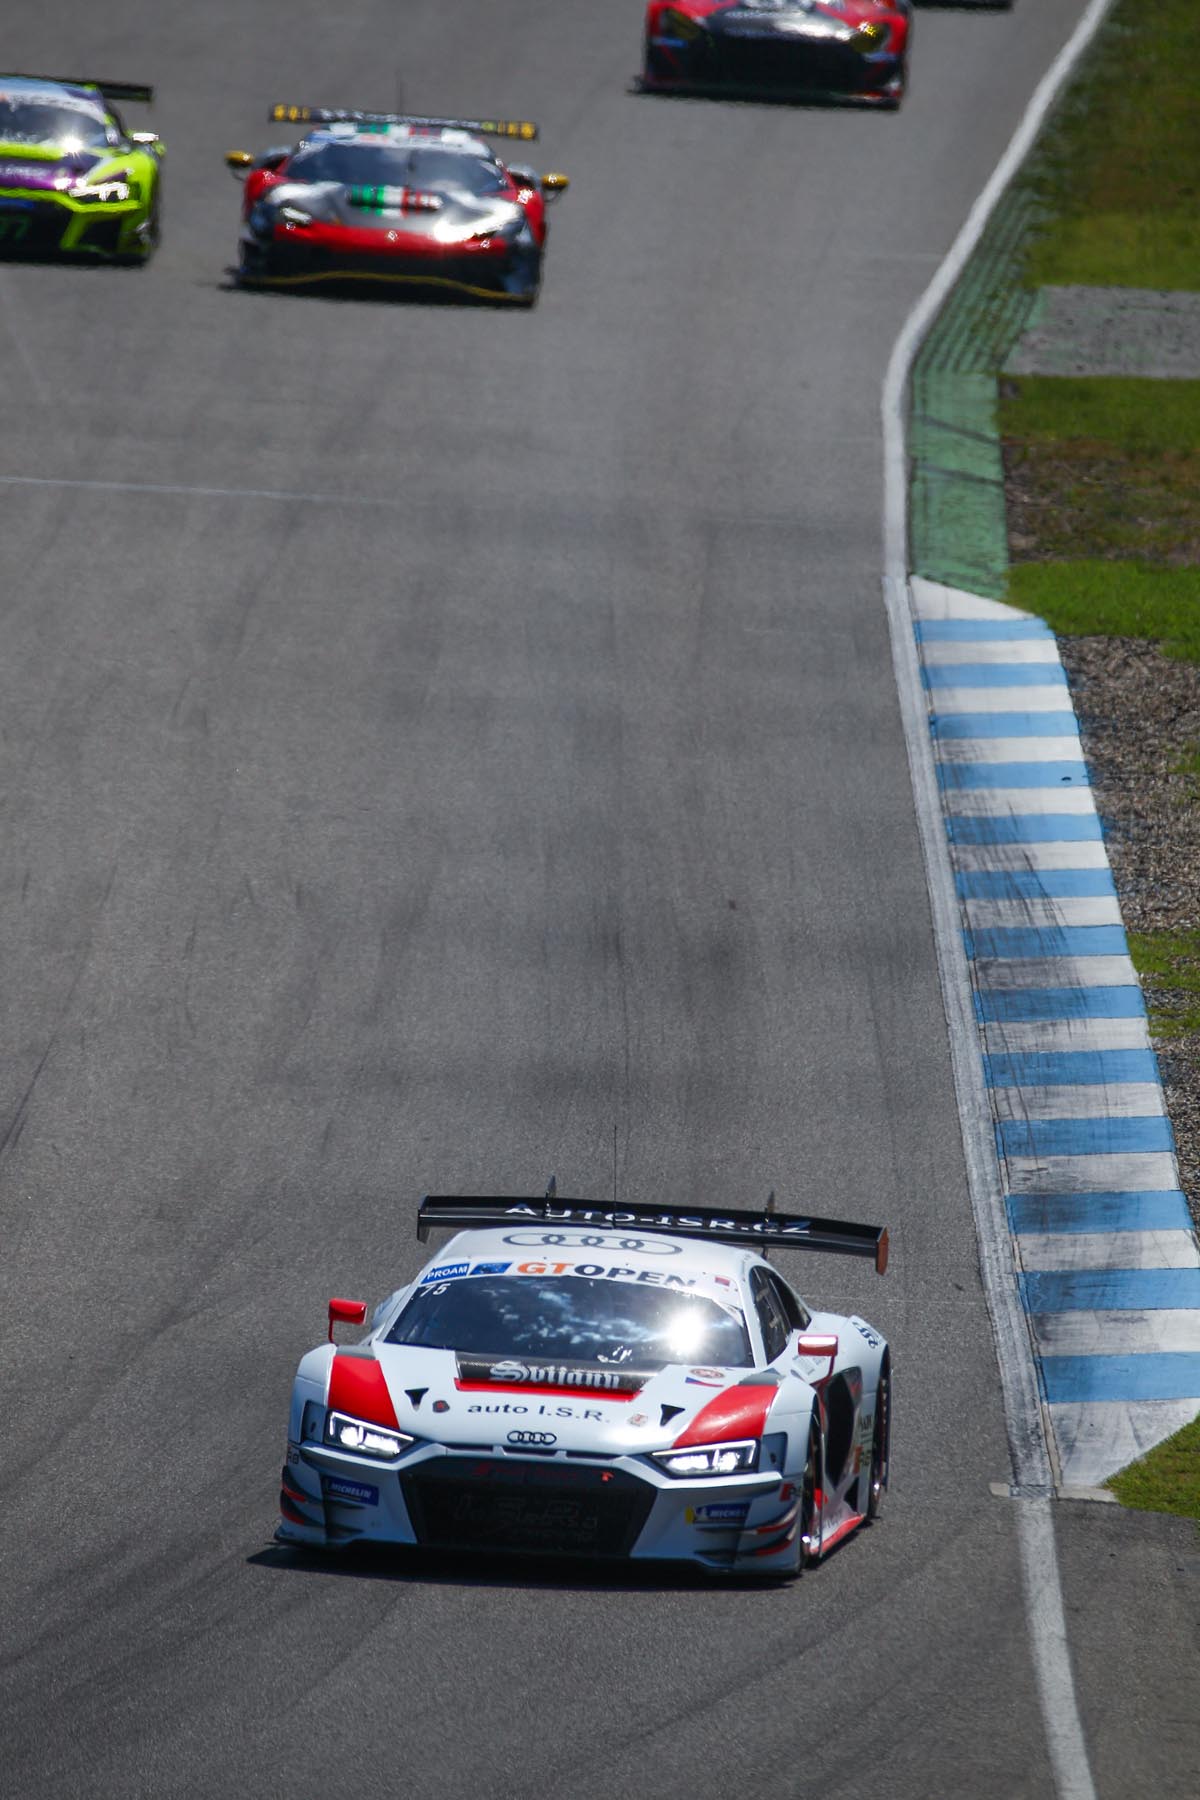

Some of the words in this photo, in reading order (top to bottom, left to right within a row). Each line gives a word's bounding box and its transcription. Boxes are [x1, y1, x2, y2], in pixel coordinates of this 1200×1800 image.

[426, 1265, 468, 1280] PROAM
[420, 1282, 452, 1298] 75
[467, 1403, 529, 1415] auto
[538, 1404, 611, 1423] I.S.R.
[330, 1482, 374, 1498] MICHELIN
